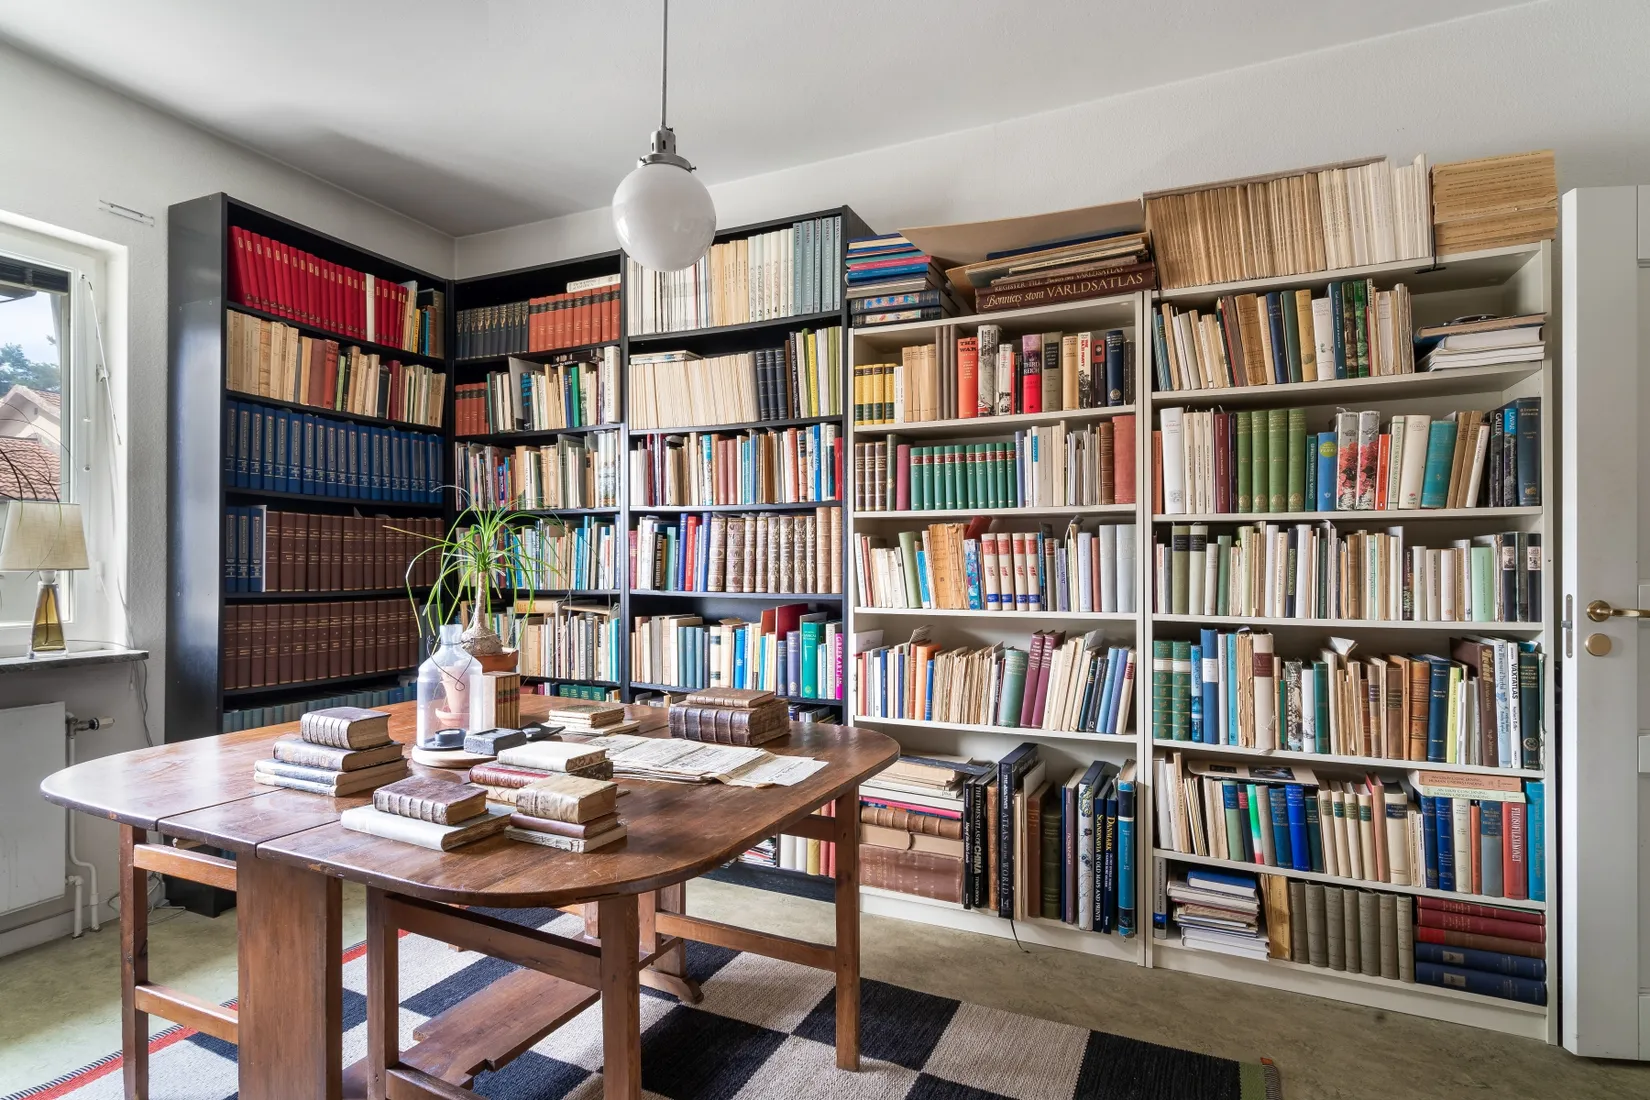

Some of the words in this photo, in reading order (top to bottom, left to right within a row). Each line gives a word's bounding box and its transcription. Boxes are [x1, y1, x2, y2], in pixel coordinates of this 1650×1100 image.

[983, 293, 1022, 308] Bonniers
[1024, 290, 1044, 301] stora
[1046, 272, 1143, 298] VÄRLDSATLAS
[995, 282, 1026, 292] REGISTER
[1028, 280, 1043, 288] TILL
[1106, 816, 1116, 851] DANMARK
